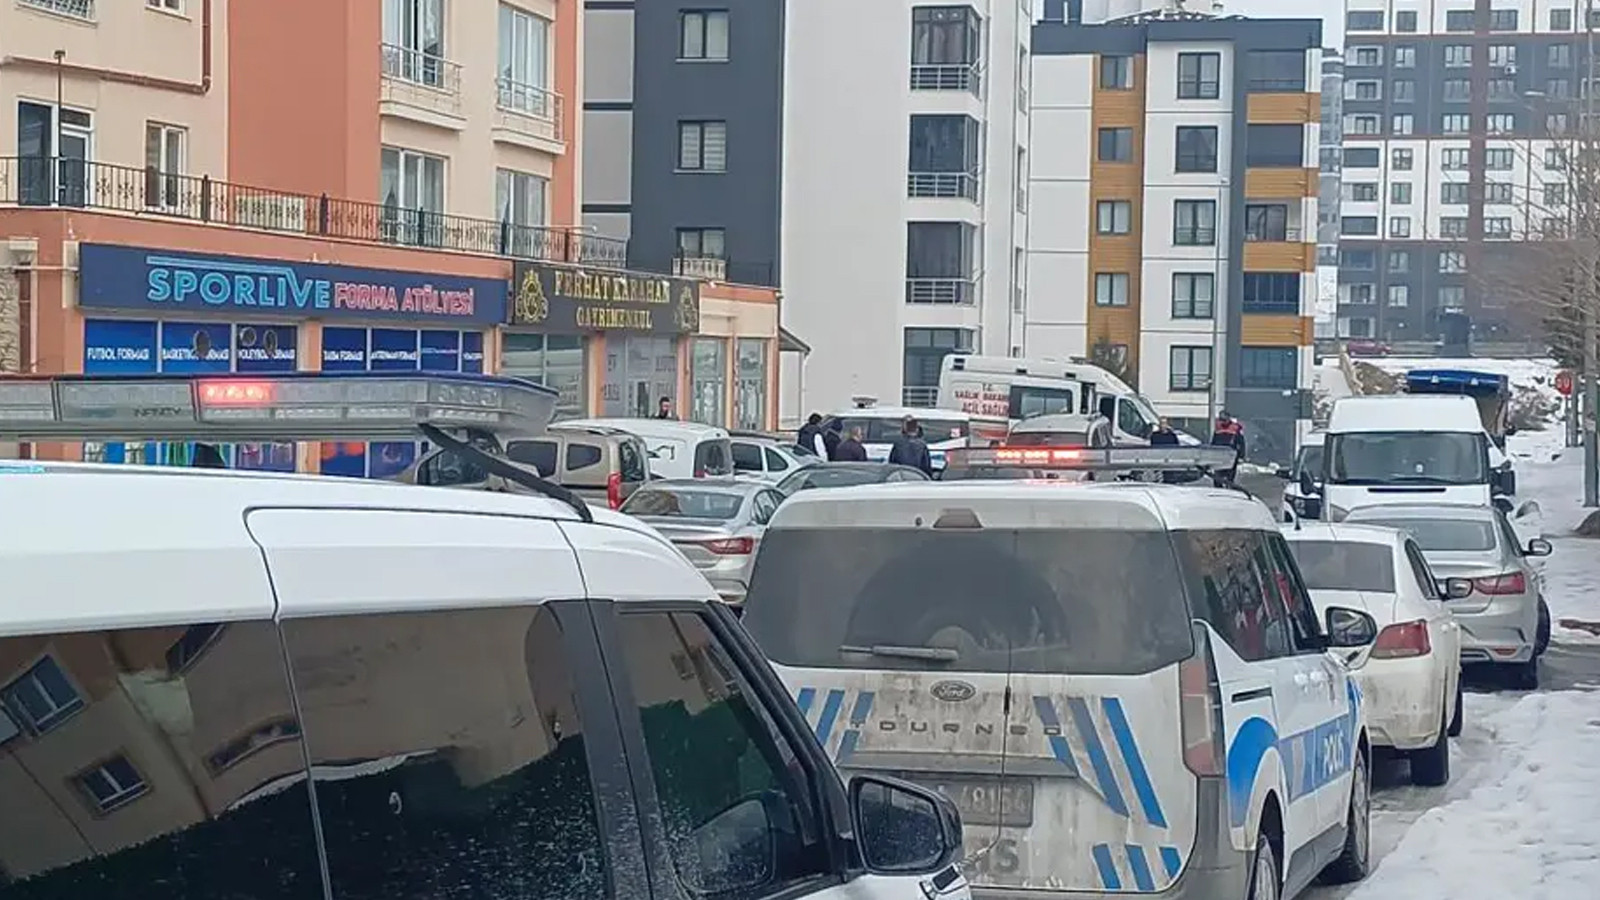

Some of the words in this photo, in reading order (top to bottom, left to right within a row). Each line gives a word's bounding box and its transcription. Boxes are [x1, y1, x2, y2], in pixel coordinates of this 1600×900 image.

[334, 282, 399, 312] FORMA
[554, 270, 610, 301] FERHAT
[87, 348, 116, 361] FUTBOL
